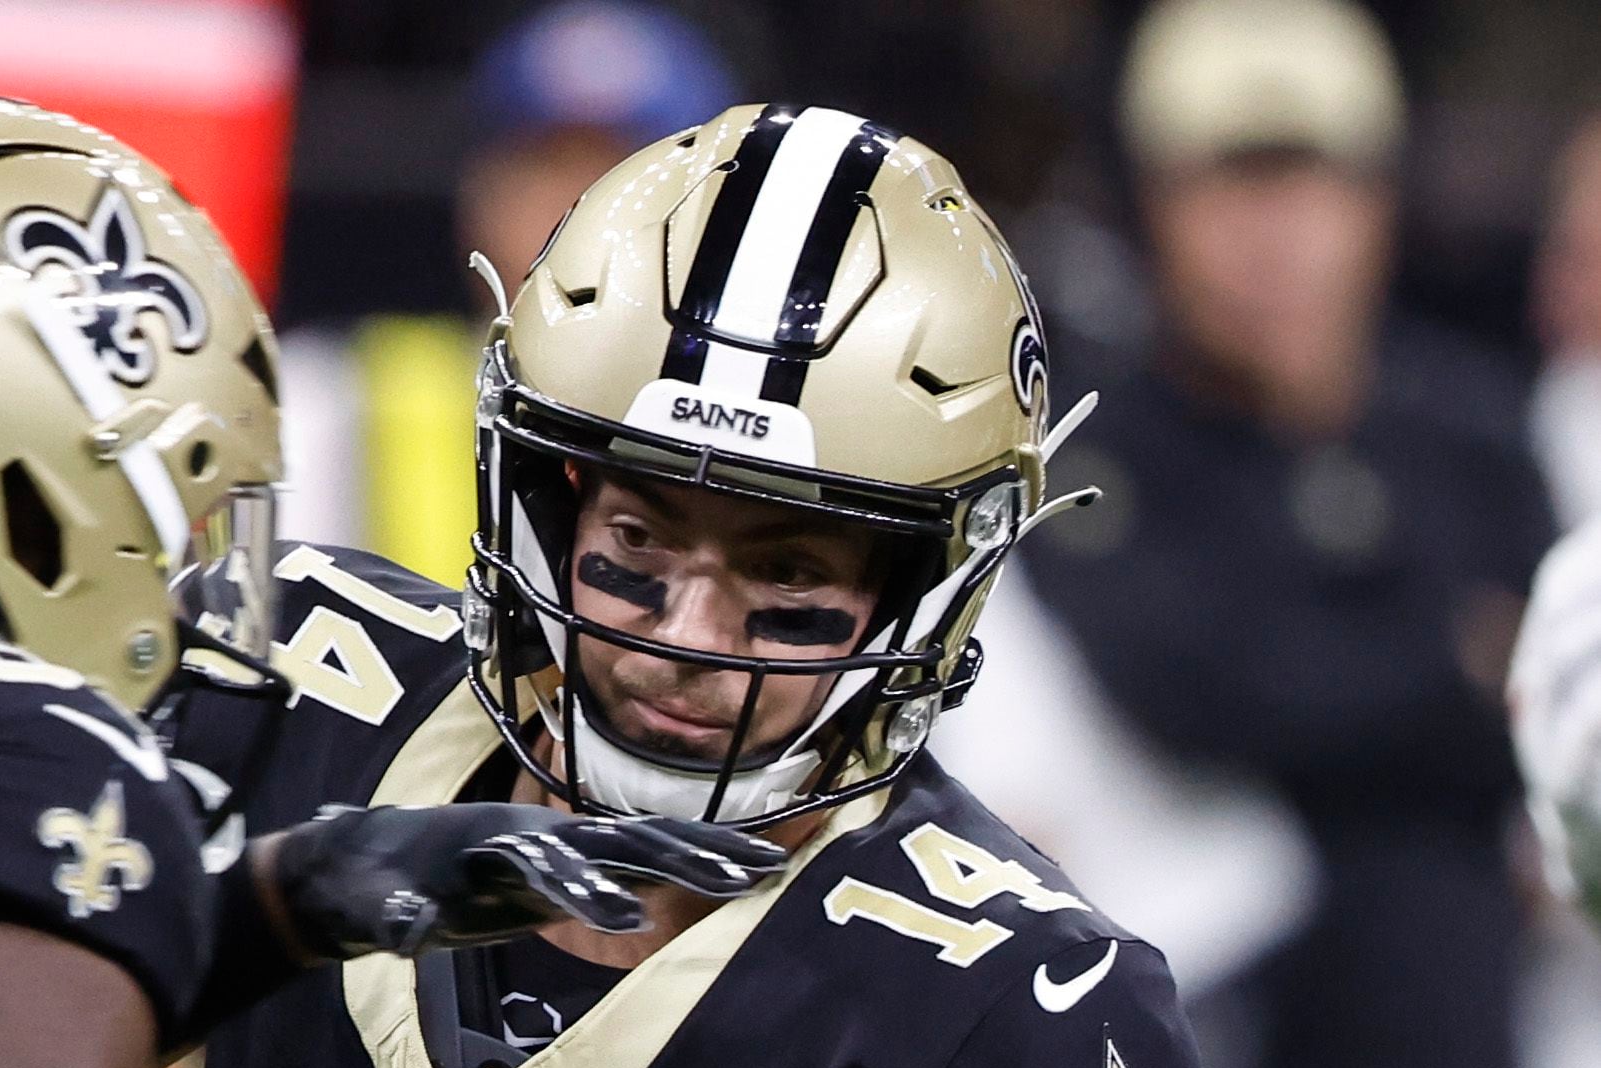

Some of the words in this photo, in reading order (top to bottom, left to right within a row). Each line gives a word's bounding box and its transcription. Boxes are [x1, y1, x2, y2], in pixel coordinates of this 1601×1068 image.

[671, 396, 771, 438] SAINTS
[268, 543, 465, 727] 14
[822, 821, 1094, 969] 14
